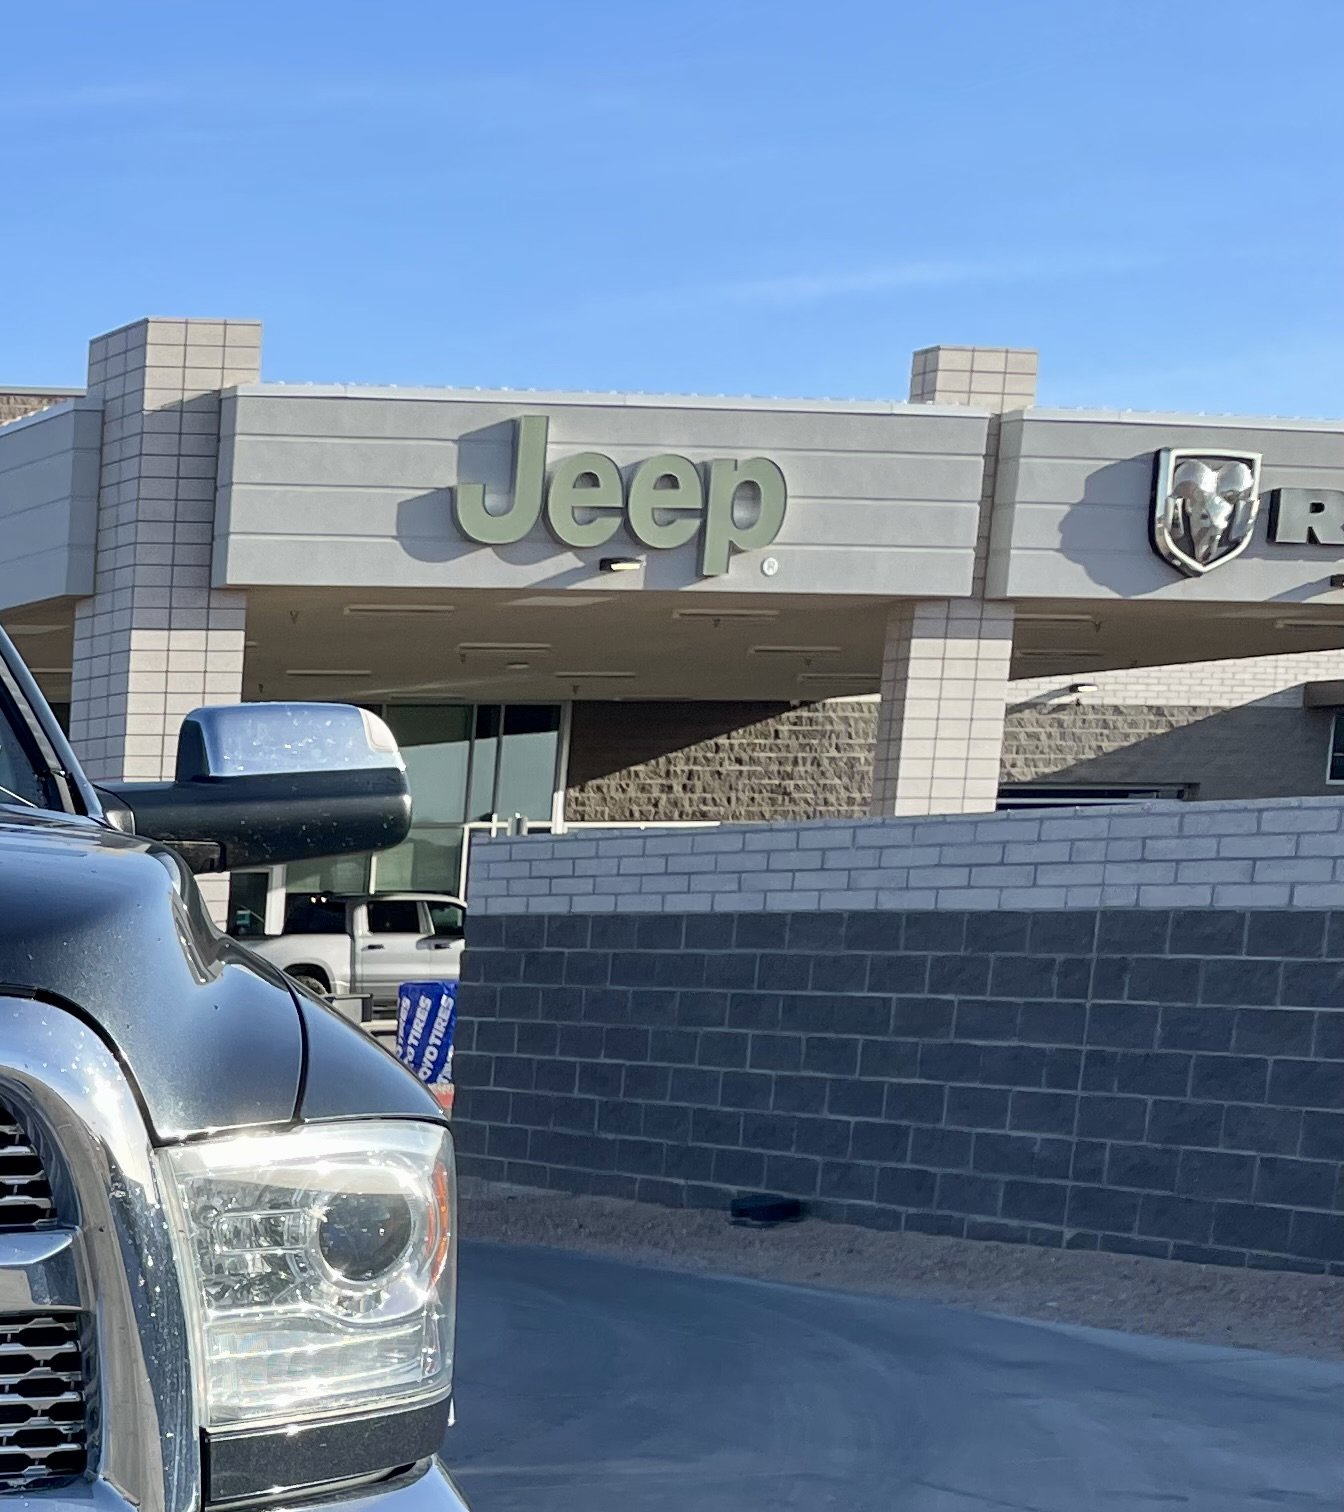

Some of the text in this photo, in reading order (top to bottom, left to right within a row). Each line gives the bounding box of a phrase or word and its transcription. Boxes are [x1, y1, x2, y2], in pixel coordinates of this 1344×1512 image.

[453, 414, 789, 577] Jeep
[407, 994, 433, 1047] TIRES
[428, 993, 455, 1046] TIRES
